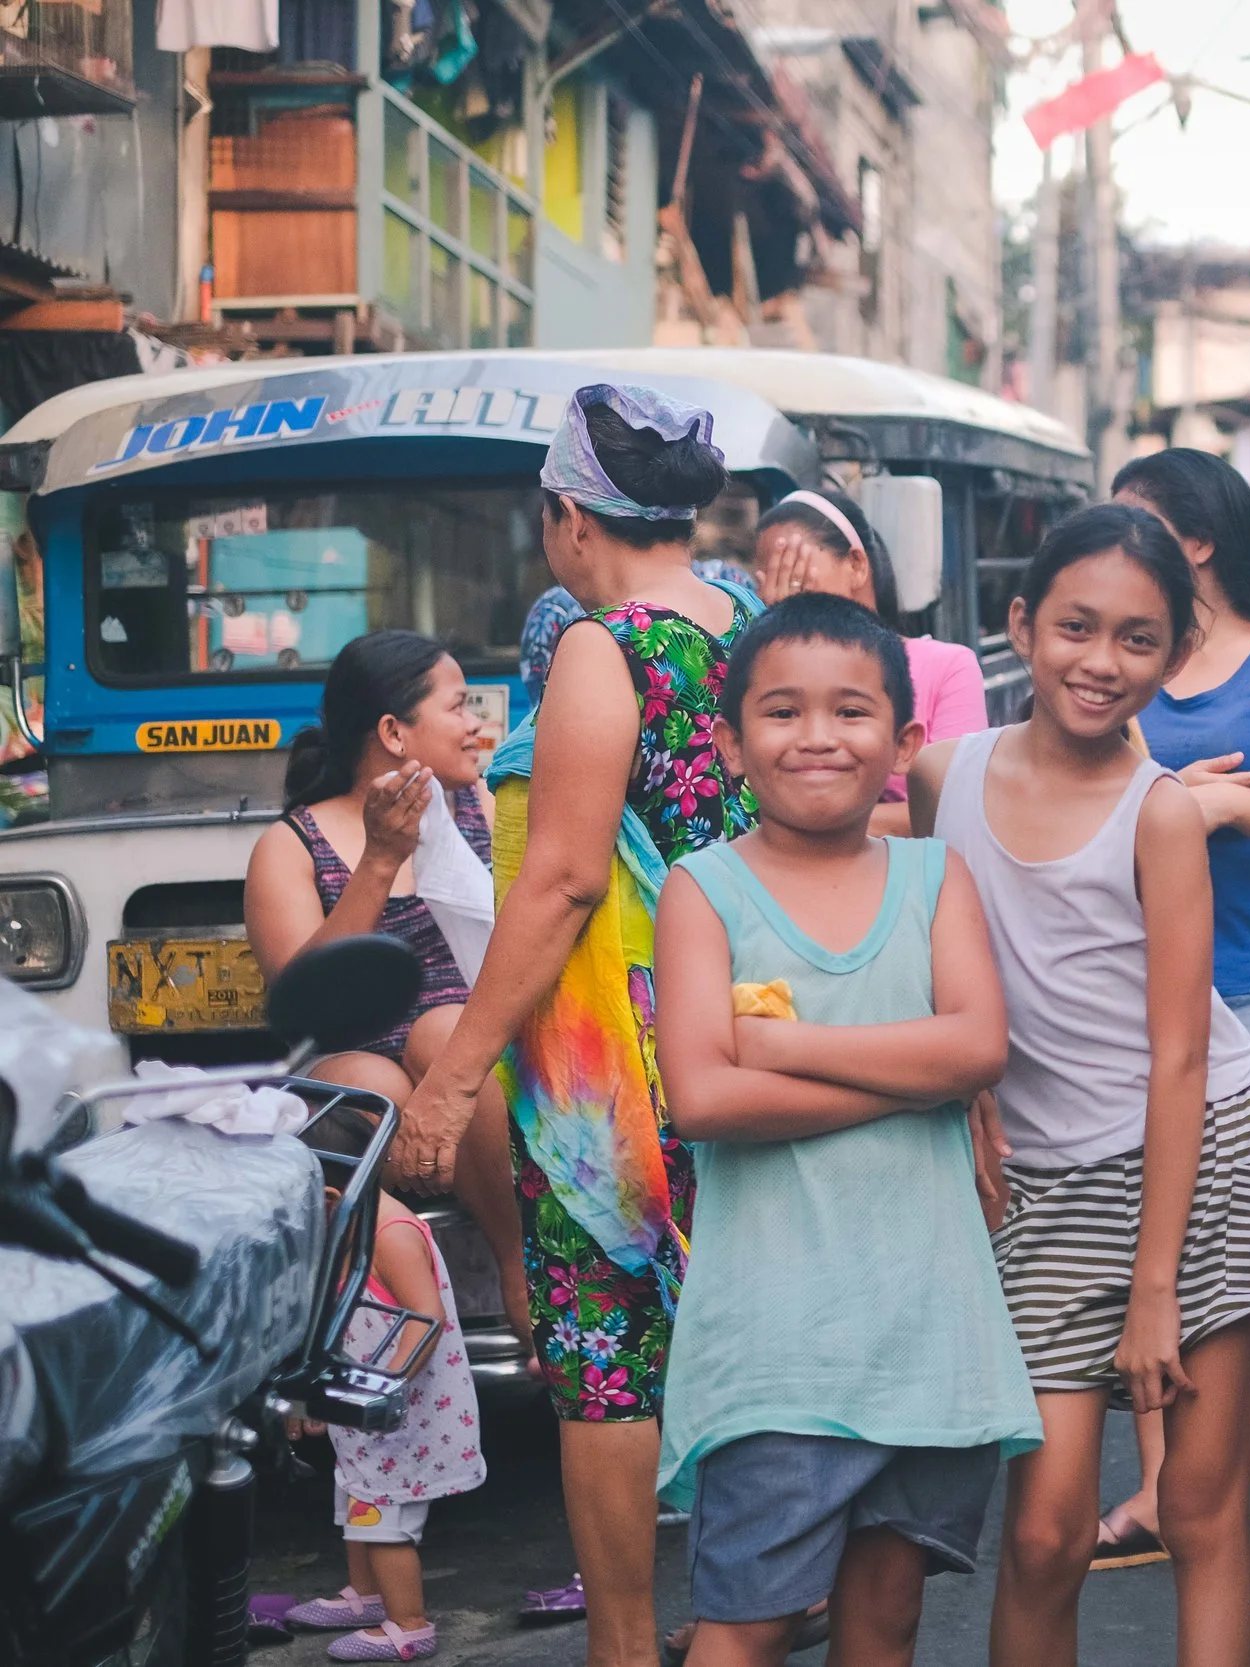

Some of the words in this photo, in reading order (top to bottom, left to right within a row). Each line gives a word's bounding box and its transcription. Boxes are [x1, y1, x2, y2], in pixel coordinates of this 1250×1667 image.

[90, 396, 327, 474] JOHN
[147, 726, 198, 748] SAN
[203, 723, 270, 746] JUAN
[116, 949, 213, 1000] NXT
